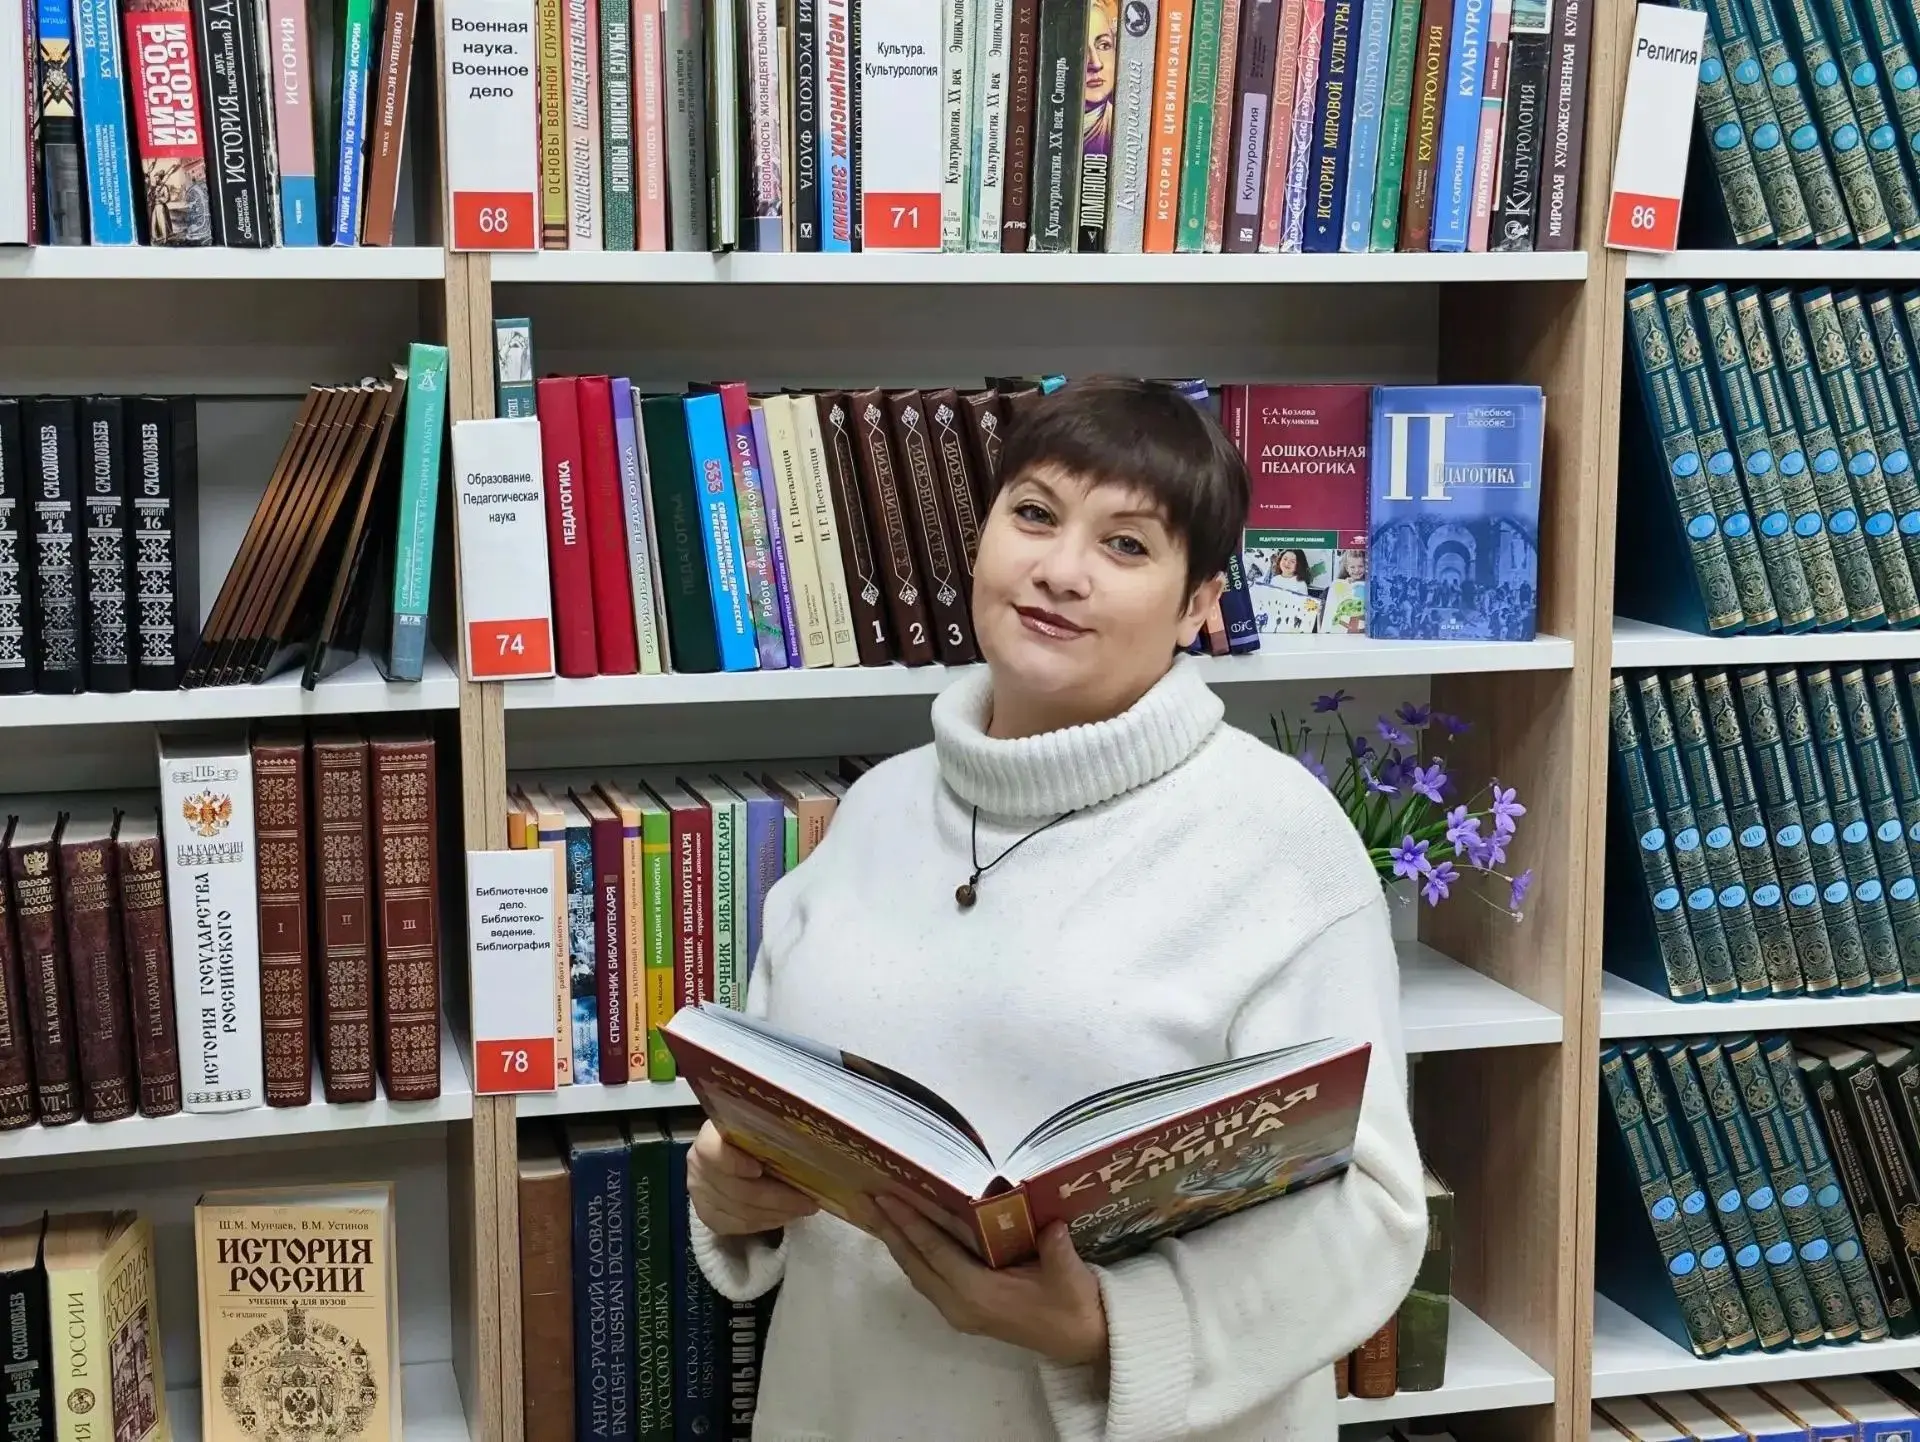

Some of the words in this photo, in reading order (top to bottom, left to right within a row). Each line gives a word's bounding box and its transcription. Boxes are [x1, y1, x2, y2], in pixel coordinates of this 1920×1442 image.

[210, 20, 231, 30] В
[350, 22, 361, 67] ИСТОРИИ
[389, 12, 404, 73] НОВЕЙШАЯ
[451, 19, 528, 33] Военная
[463, 43, 518, 57] наука.
[608, 23, 627, 74] СЛУЖБЫ
[877, 42, 926, 57] Культура.
[1330, 2, 1350, 74] КУЛЬТУРЫ
[214, 53, 225, 75] ДВУХ
[223, 32, 238, 94] ТЫСЯЧЕЛЕТИЙ
[281, 18, 300, 104] ИСТОРИЯ
[452, 63, 529, 76] Военное
[757, 2, 769, 117] ЖИЗНЕДЕЯТЕЛЬНОСТИ
[799, 32, 813, 122] РУССКОГО
[865, 64, 938, 78] Культурология
[1015, 33, 1030, 113] КУЛЬТУРЫ
[1163, 11, 1181, 135] ЦИВИЛИЗАЦИЙ
[1636, 38, 1698, 66] Религия
[142, 25, 177, 146] РОССИИ
[165, 24, 198, 145] ИСТОРИЯ
[346, 70, 358, 126] ВСЕМИРНОЙ
[384, 77, 398, 126] ИСТОРИЯ
[469, 86, 513, 99] дело
[544, 66, 560, 127] ВОЕННОЙ
[826, 13, 849, 158] медицинских
[951, 69, 961, 86] век
[990, 73, 1001, 90] век
[1051, 57, 1068, 104] Словарь
[1418, 25, 1443, 161] КУЛЬТУРОЛОГИЯ
[609, 81, 628, 139] ВОИНСКОЙ
[1053, 107, 1064, 129] век.
[1323, 81, 1343, 148] МИРОВОЙ
[1554, 44, 1575, 168] ХУДОЖЕСТВЕННАЯ
[218, 96, 247, 183] ИСТОРИЯ
[345, 130, 354, 143] ПО
[760, 121, 772, 199] БЕЗОПАСНОСТЬ
[799, 130, 813, 190] ФЛОТА
[945, 108, 961, 184] Культурология.
[984, 112, 1001, 188] Культурология.
[1116, 60, 1142, 214] Культурология
[1242, 108, 1261, 200] Культурология
[343, 147, 353, 192] РЕФЕРАТЫ
[547, 133, 561, 194] ОСНОВЫ
[572, 137, 591, 238] БЕЗОПАСНОСТЬ
[611, 146, 629, 192] ОСНОВЫ
[1012, 125, 1025, 206] СЛОВАРЬ
[1157, 147, 1172, 220] ИСТОРИЯ
[1317, 156, 1337, 218] ИСТОРИЯ
[1452, 145, 1465, 203] САПРОНОВ
[1476, 128, 1494, 217] КУЛЬТУРОЛОГИЯ
[235, 197, 245, 231] Алексей
[240, 189, 252, 239] Овсянников
[341, 196, 350, 233] ЛУЧШИЕ
[830, 164, 853, 241] знаний
[1045, 152, 1064, 237] Культурология.
[1081, 153, 1107, 229] ЛОМОНОСОВ
[1549, 175, 1565, 237] МИРОВАЯ
[479, 208, 508, 233] 68
[890, 207, 919, 228] 71
[1631, 207, 1656, 229] 86
[1281, 417, 1319, 427] Куликова
[1282, 408, 1316, 417] Козлова
[1473, 407, 1512, 417] Учебное
[736, 433, 752, 457] ДОУ
[1261, 444, 1366, 458] ДОШКОЛЬНАЯ
[1261, 461, 1356, 474] ПЕДАГОГИКА
[463, 491, 539, 506] Педагогическая
[467, 472, 534, 486] Образование.
[625, 446, 643, 544] ПЕДАГОГИКА
[703, 460, 724, 493] 333
[781, 449, 799, 516] Песталоцци
[808, 447, 827, 515] Песталоцци
[41, 511, 65, 520] КНИГА
[46, 520, 64, 533] 14
[92, 505, 116, 514] КНИГА
[96, 514, 113, 528] 15
[140, 508, 165, 516] КНИГА
[144, 517, 162, 530] 16
[489, 511, 516, 524] наука
[558, 460, 576, 545] ПЕДАГОГИКА
[744, 469, 767, 575] педагога-психолога
[712, 513, 730, 592] СПЕЦИАЛЬНОСТИ
[717, 501, 735, 575] СОВРЕМЕННЫЕ
[729, 576, 744, 634] ПРОФЕССИИ
[636, 552, 653, 655] СОЦИАЛЬНАЯ
[760, 580, 773, 617] Работа
[496, 634, 525, 655] 74
[872, 620, 885, 644] 1
[909, 622, 925, 645] 2
[947, 623, 964, 645] 3
[195, 766, 215, 777] ПБ
[476, 886, 548, 898] Библиотечное
[574, 852, 585, 885] доступ
[652, 857, 662, 904] БИБЛИОТЕКА
[681, 832, 693, 932] БИБЛИОТЕКАРЯ
[718, 811, 731, 932] БИБЛИОТЕКАРЯ
[277, 922, 284, 933] I
[341, 914, 352, 925] II
[402, 919, 416, 930] III
[481, 914, 544, 925] Библиотеко-
[499, 901, 527, 911] дело.
[574, 888, 585, 938] Открытый
[606, 886, 618, 968] БИБЛИОТЕКАРЯ
[696, 884, 704, 936] переработанное
[194, 872, 215, 999] ГОСУДАРСТВА
[476, 941, 551, 952] Библиография
[491, 929, 536, 937] ведение.
[556, 916, 564, 957] библиотек
[654, 913, 663, 964] КРАЕВЕДЕНИЕ
[696, 939, 704, 974] издание,
[217, 910, 237, 1033] РОССИЙСКОГО
[557, 962, 567, 989] работа
[631, 948, 639, 998] ЭЛЕКТРОННЫЙ
[608, 972, 621, 1043] СПРАВОЧНИК
[202, 1008, 219, 1085] ИСТОРИЯ
[501, 1051, 529, 1073] 78
[1058, 1083, 1320, 1199] КРАСНАЯ
[1112, 1087, 1282, 1163] БОЛЬШАЯ
[1108, 1117, 1285, 1194] КНИГА
[251, 1221, 297, 1232] Мунчаев,
[328, 1221, 369, 1231] Устинов
[587, 1195, 604, 1277] СЛОВАРЬ
[606, 1168, 624, 1274] DICTIONARY
[636, 1176, 650, 1251] СЛОВАРЬ
[216, 1238, 374, 1265] ИСТОРИЯ
[102, 1246, 149, 1316] ИСТОРИЯ
[228, 1266, 365, 1293] РОССИИ
[248, 1298, 288, 1306] УЧЕБНИК
[300, 1298, 317, 1306] ДЛЯ
[105, 1274, 148, 1338] РОССИИ
[654, 1281, 669, 1341] ЯЗЫКА
[68, 1291, 87, 1377] РОССИИ
[587, 1280, 608, 1438] АНГЛО-РУССКИЙ
[636, 1257, 655, 1434] ФРАЗЕОЛОГИЧЕСКИЙ
[13, 1379, 31, 1393] 18
[654, 1344, 672, 1430] РУССКОГО
[729, 1315, 756, 1424] БОЛЬШОЙ
